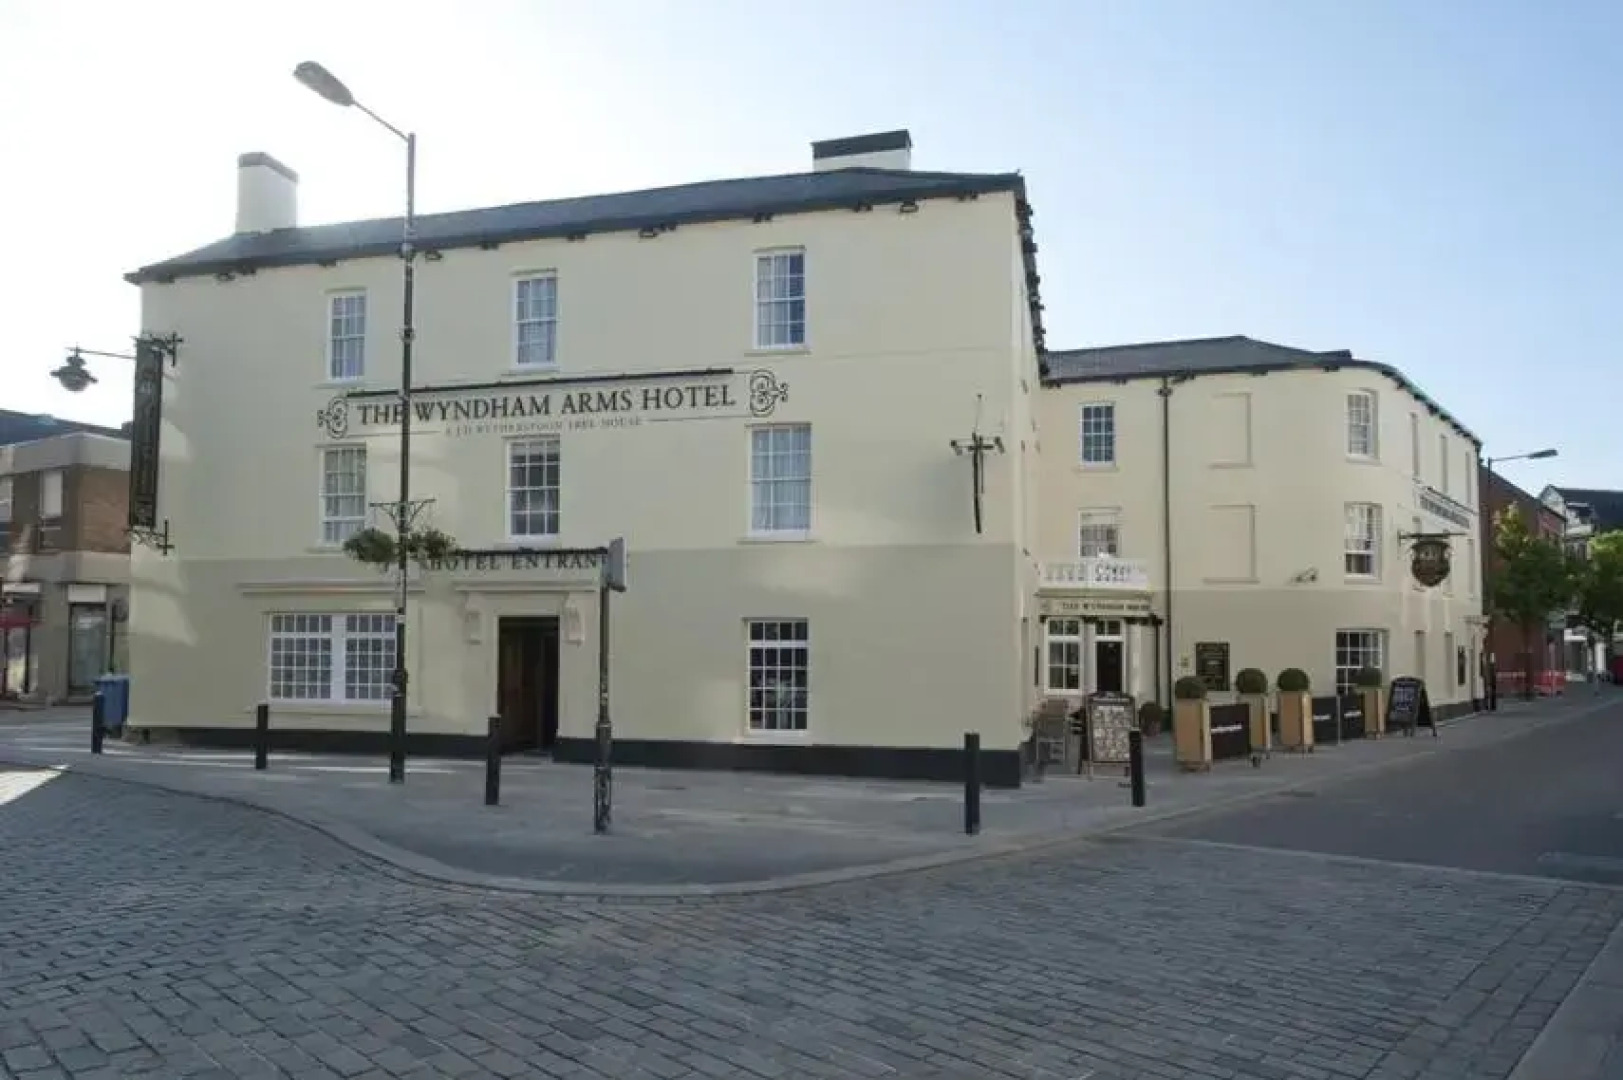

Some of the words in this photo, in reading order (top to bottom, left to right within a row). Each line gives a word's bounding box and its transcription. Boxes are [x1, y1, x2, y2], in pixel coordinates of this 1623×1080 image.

[414, 394, 550, 422] WYNDHAM
[561, 388, 632, 415] ARMS
[641, 384, 737, 411] HOTEL
